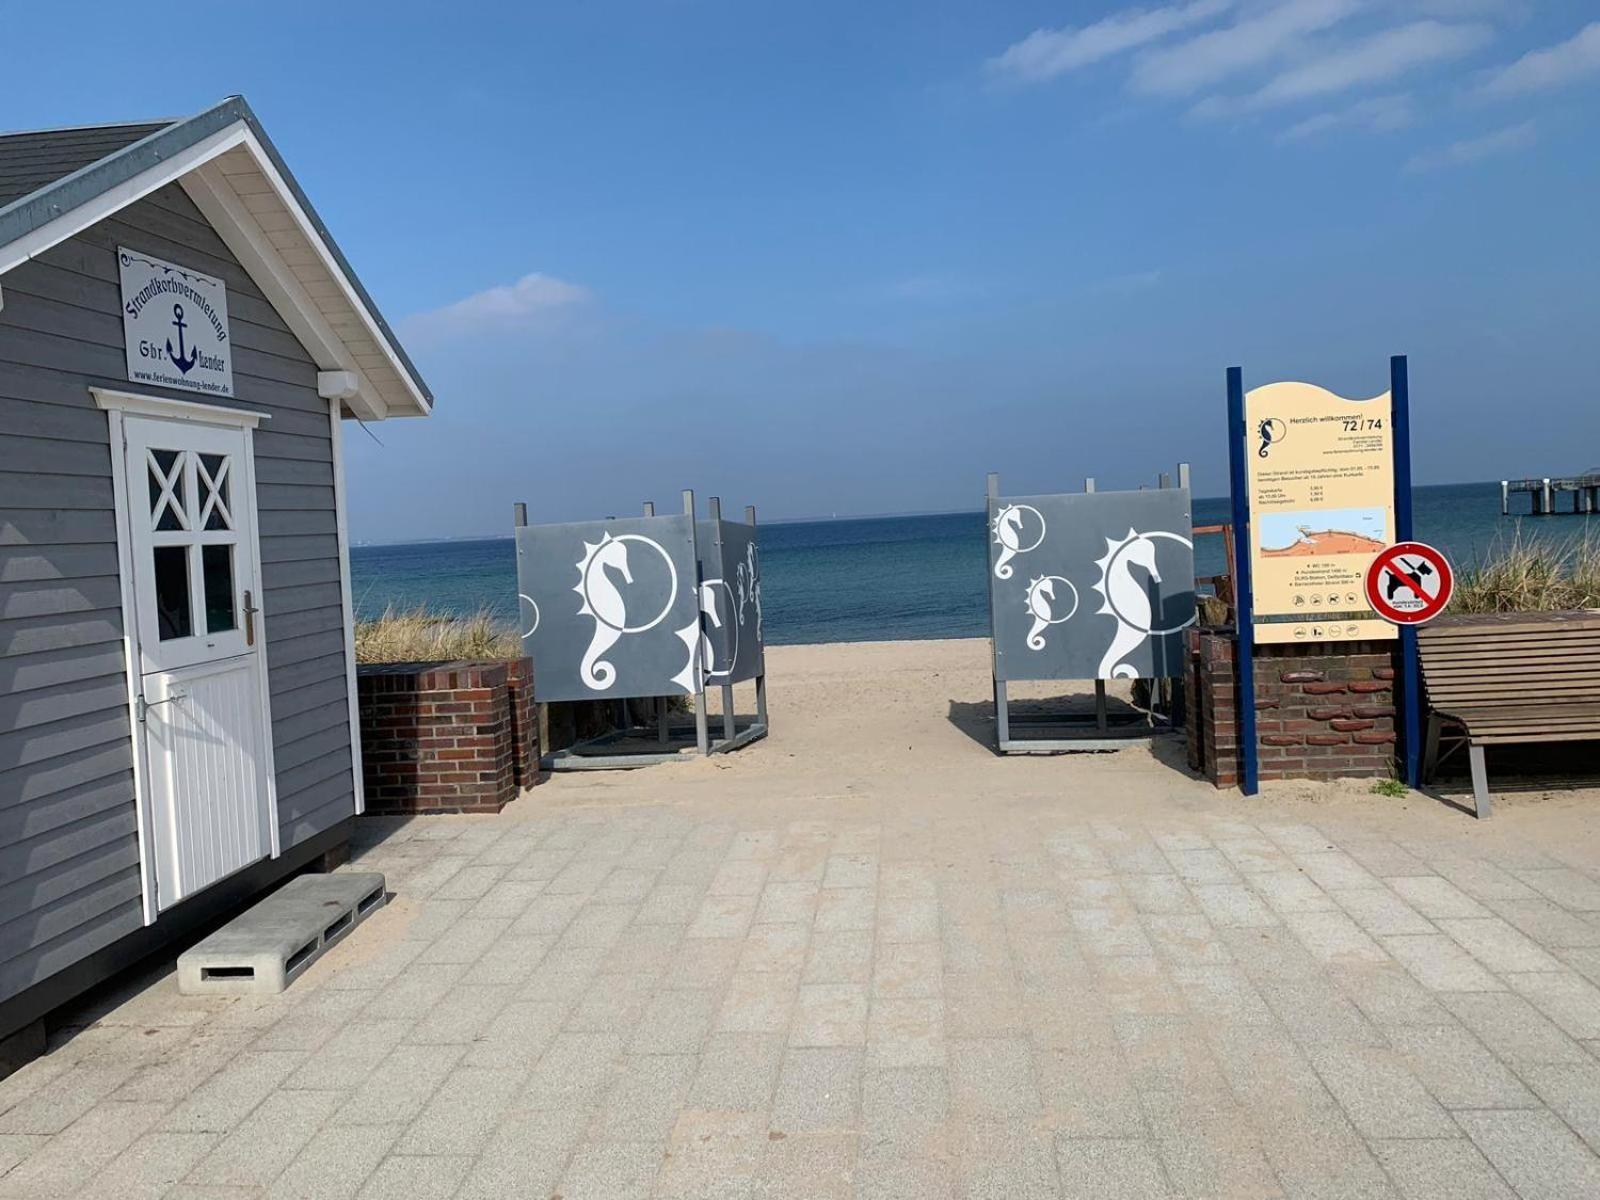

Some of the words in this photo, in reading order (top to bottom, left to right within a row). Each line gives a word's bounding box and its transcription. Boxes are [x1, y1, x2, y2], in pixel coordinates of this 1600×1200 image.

[125, 277, 227, 342] Strandkorbvermietung
[139, 340, 167, 361] Gbr.
[198, 350, 225, 373] Lender
[133, 371, 229, 393] www.ferienwohnung-lender.de
[1289, 416, 1318, 425] Herzlich
[1319, 413, 1363, 422] willkommen!
[1342, 420, 1358, 432] 72
[1367, 418, 1382, 430] 74
